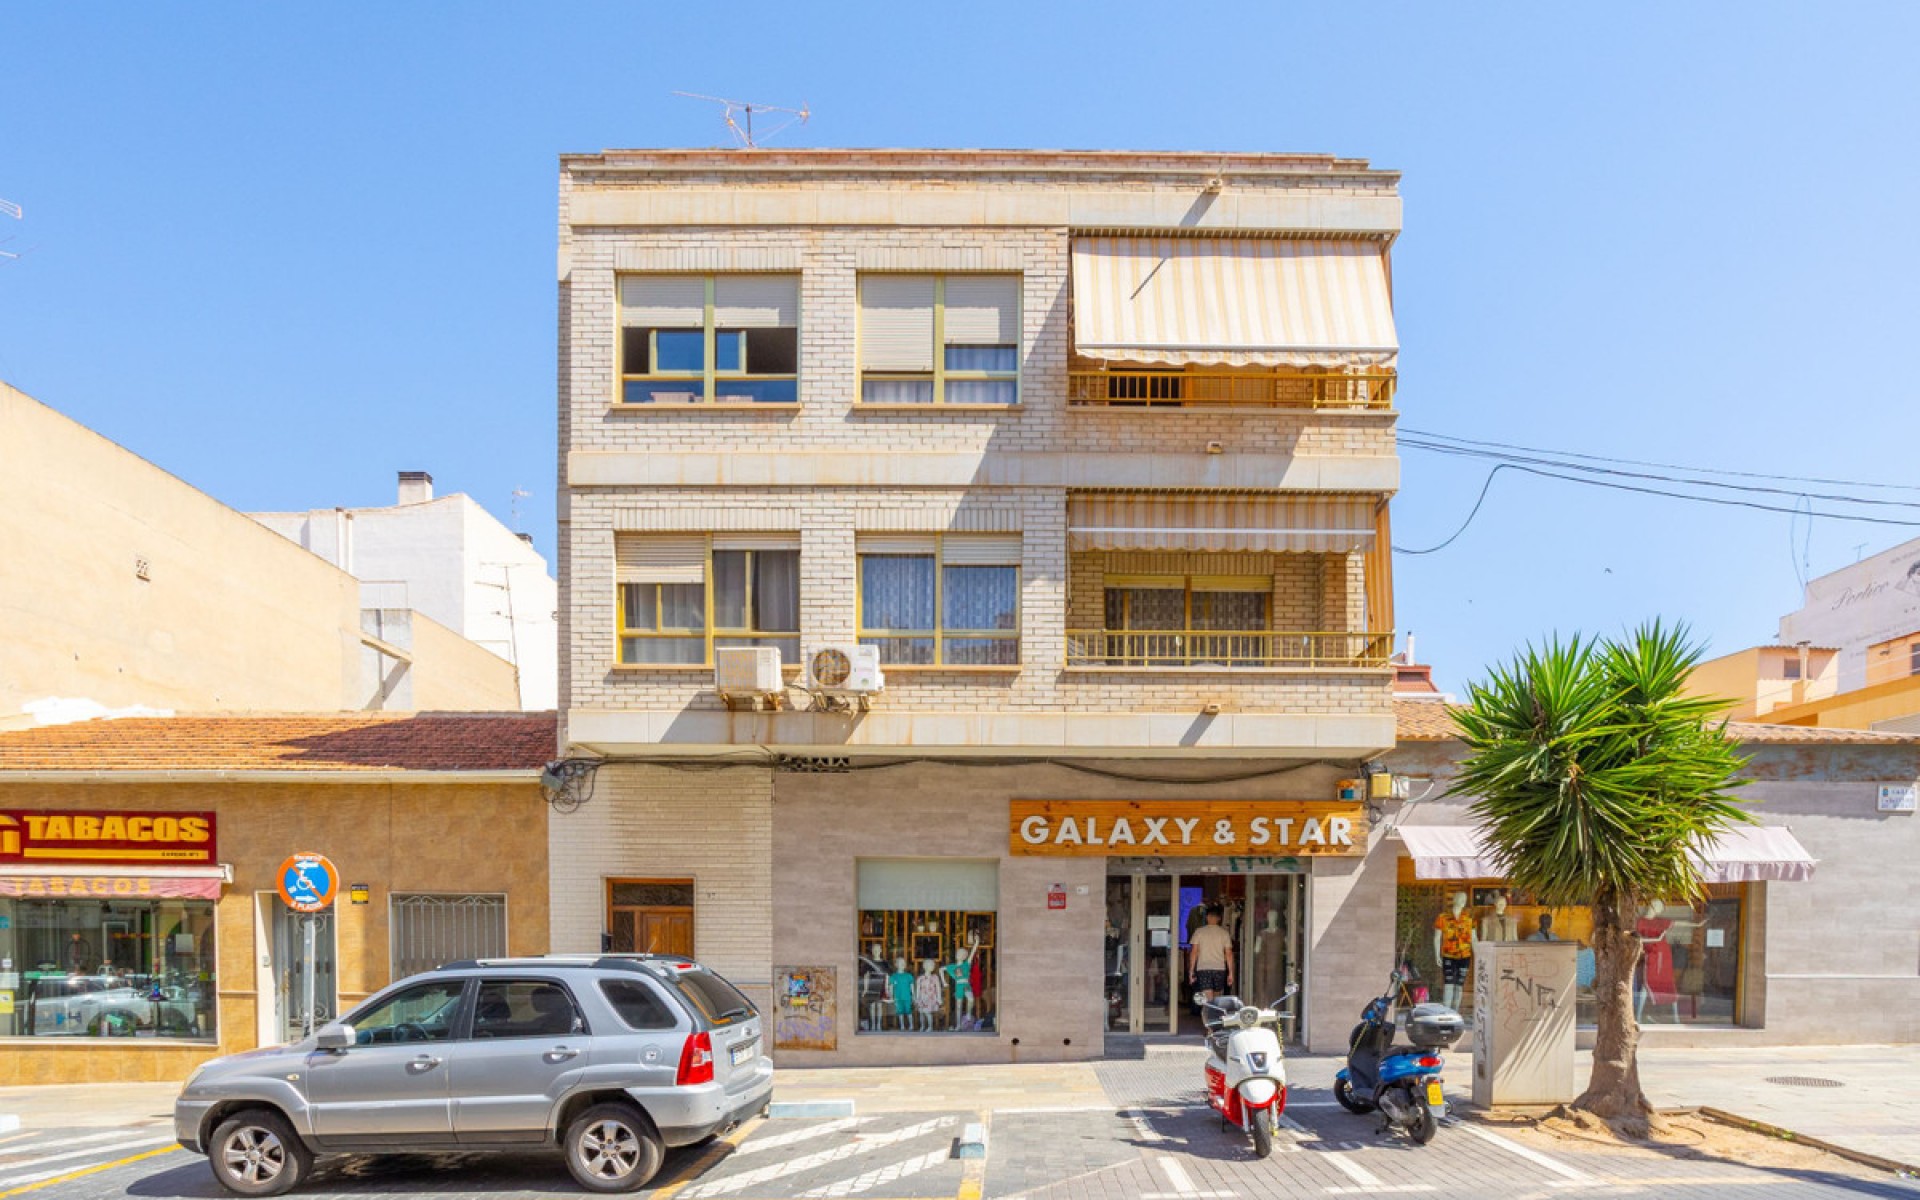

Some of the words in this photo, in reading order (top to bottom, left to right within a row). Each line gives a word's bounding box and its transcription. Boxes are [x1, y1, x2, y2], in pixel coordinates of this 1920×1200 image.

[24, 815, 209, 842] TABACOS
[1020, 816, 1199, 845] GALAXY
[1213, 819, 1236, 845] &
[1250, 816, 1352, 846] STAR
[14, 877, 152, 894] TABACOS
